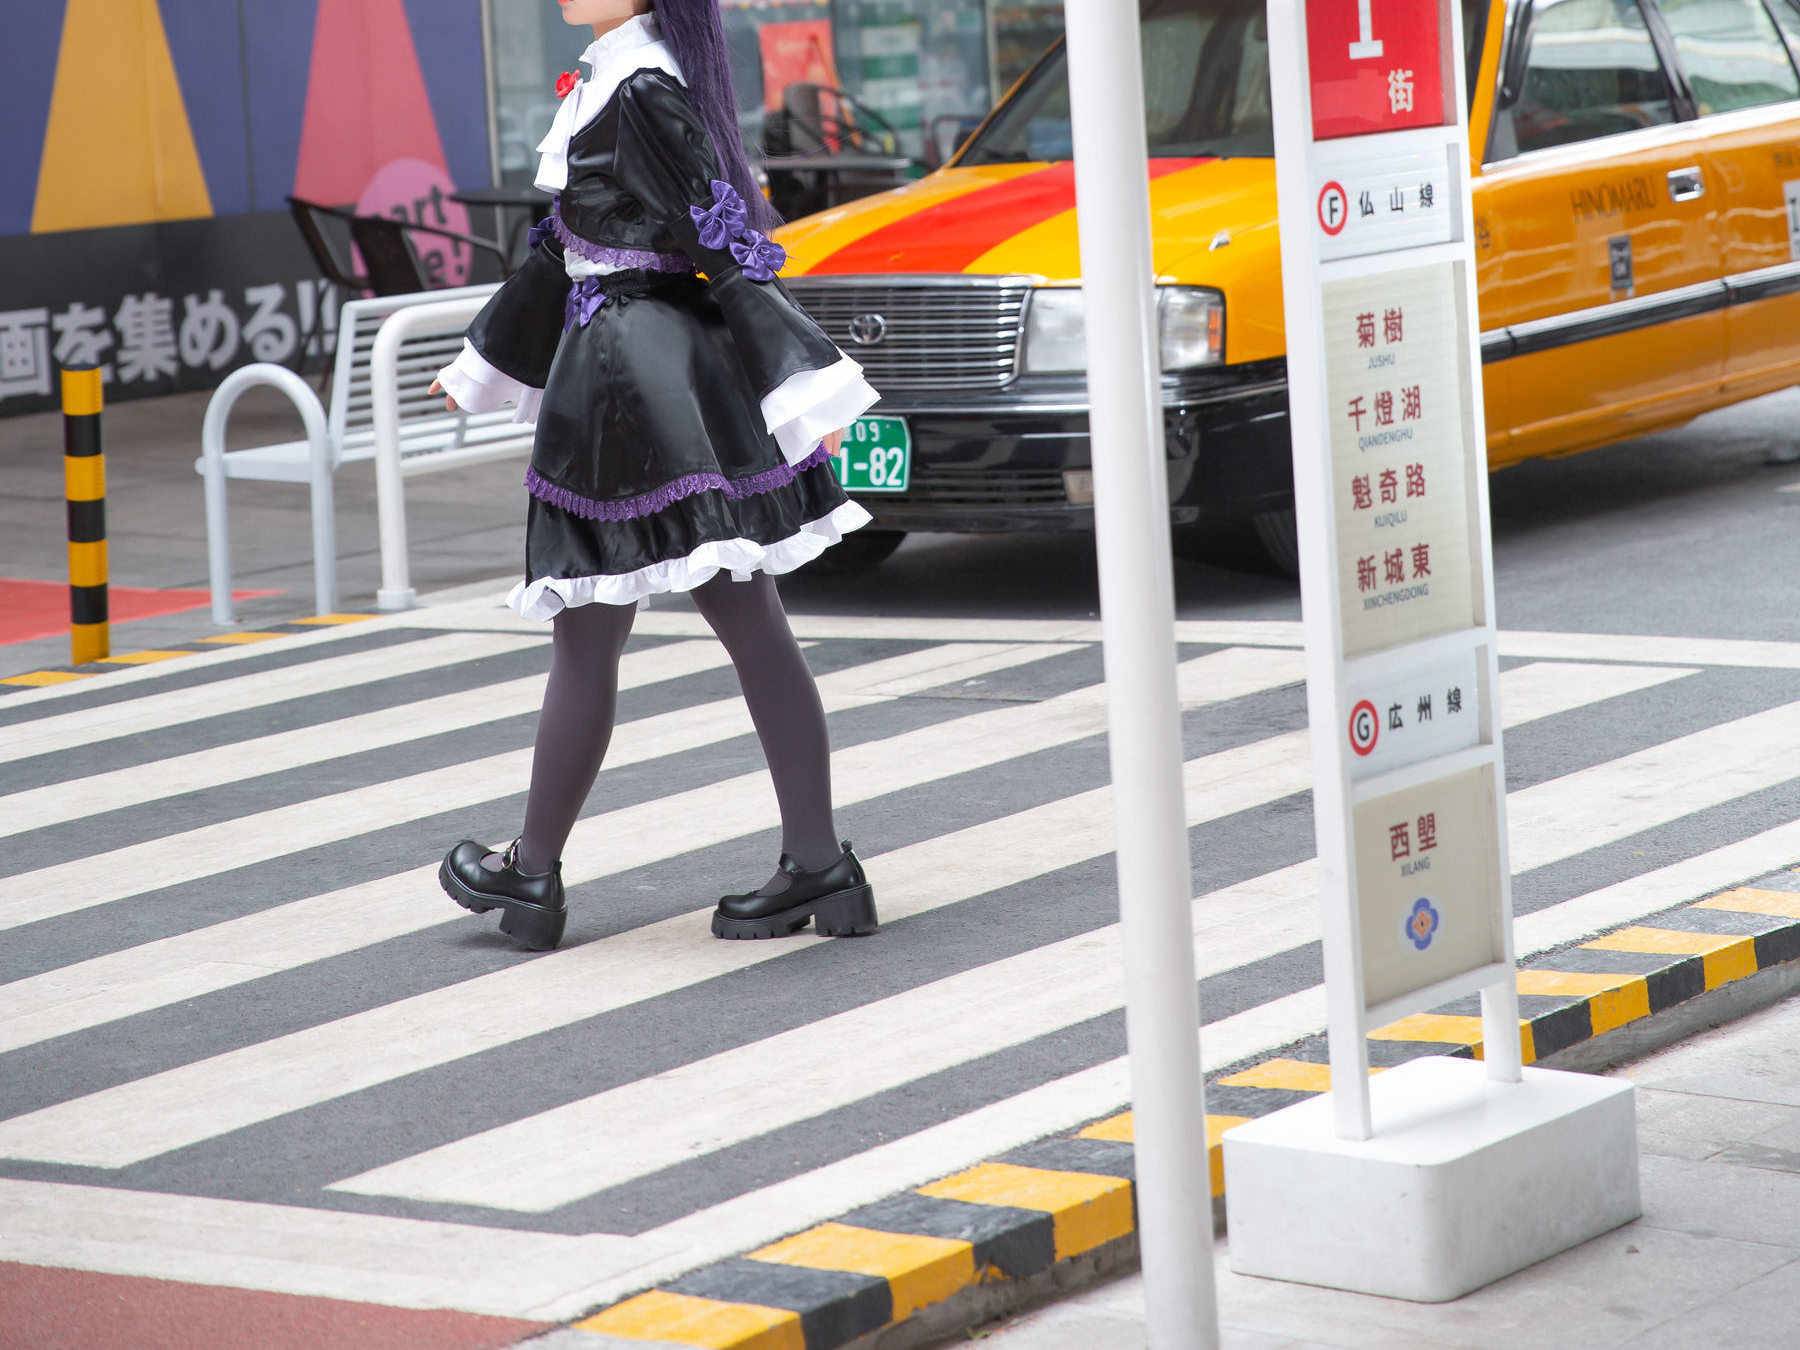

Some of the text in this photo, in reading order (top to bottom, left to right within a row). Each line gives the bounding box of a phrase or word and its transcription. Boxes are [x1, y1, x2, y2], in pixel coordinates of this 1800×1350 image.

[1387, 68, 1414, 114] 街
[1328, 195, 1339, 224] F
[1358, 183, 1435, 218] 仏山線
[1569, 176, 1656, 223] HINOMARU
[1356, 306, 1404, 349] 菊樹
[1368, 353, 1396, 370] JUSHU
[1347, 385, 1422, 433] 千燈湖
[1357, 427, 1413, 451] QIANDENGHU
[1351, 462, 1426, 511] 魁奇路
[1373, 510, 1408, 529] KUIQILU
[1356, 542, 1432, 593] 新城東
[1361, 583, 1430, 611] XINCHENGDONG
[1388, 686, 1463, 732] 広州線
[1356, 712, 1371, 742] G
[1400, 856, 1431, 878] XILANG
